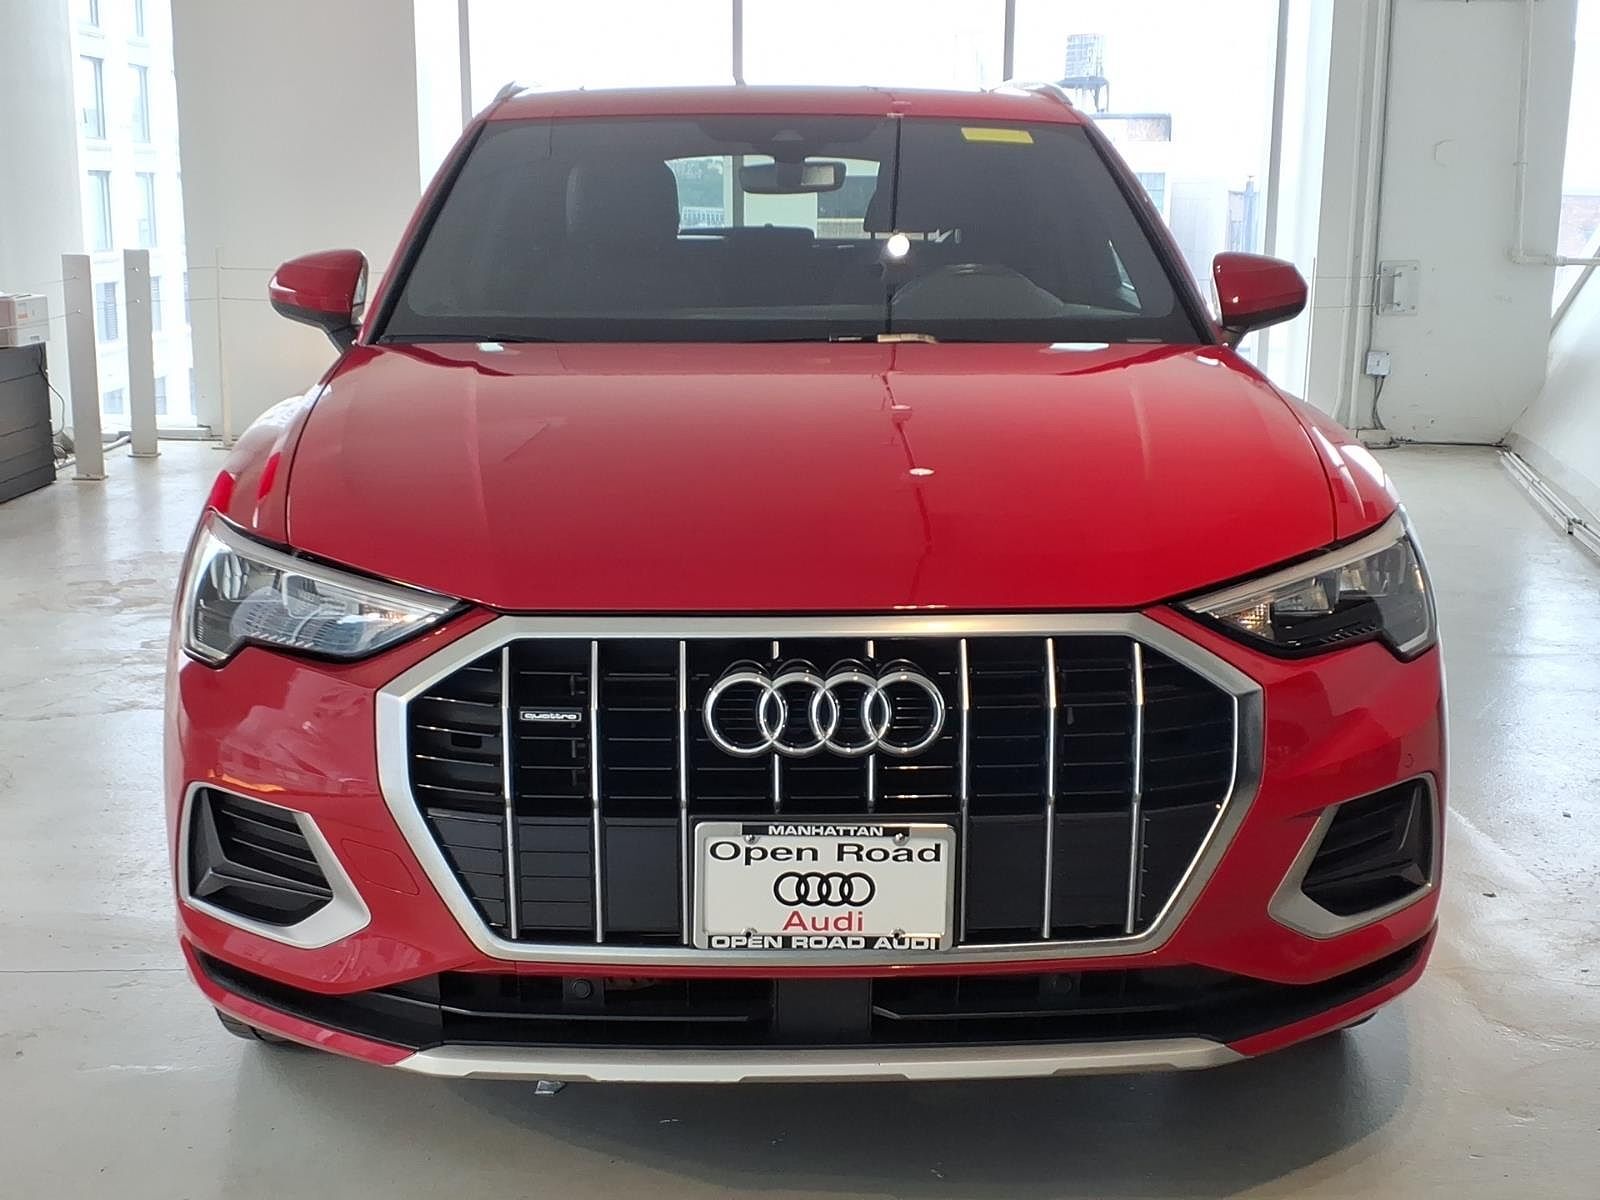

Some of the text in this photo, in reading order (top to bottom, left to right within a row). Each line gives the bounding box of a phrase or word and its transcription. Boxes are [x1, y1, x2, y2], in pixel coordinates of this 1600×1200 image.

[524, 712, 577, 720] quattro
[768, 825, 884, 837] MANHATTAN
[709, 841, 941, 866] Open Road
[782, 910, 863, 932] Audi
[711, 935, 936, 950] OPEN ROAD AUDI
